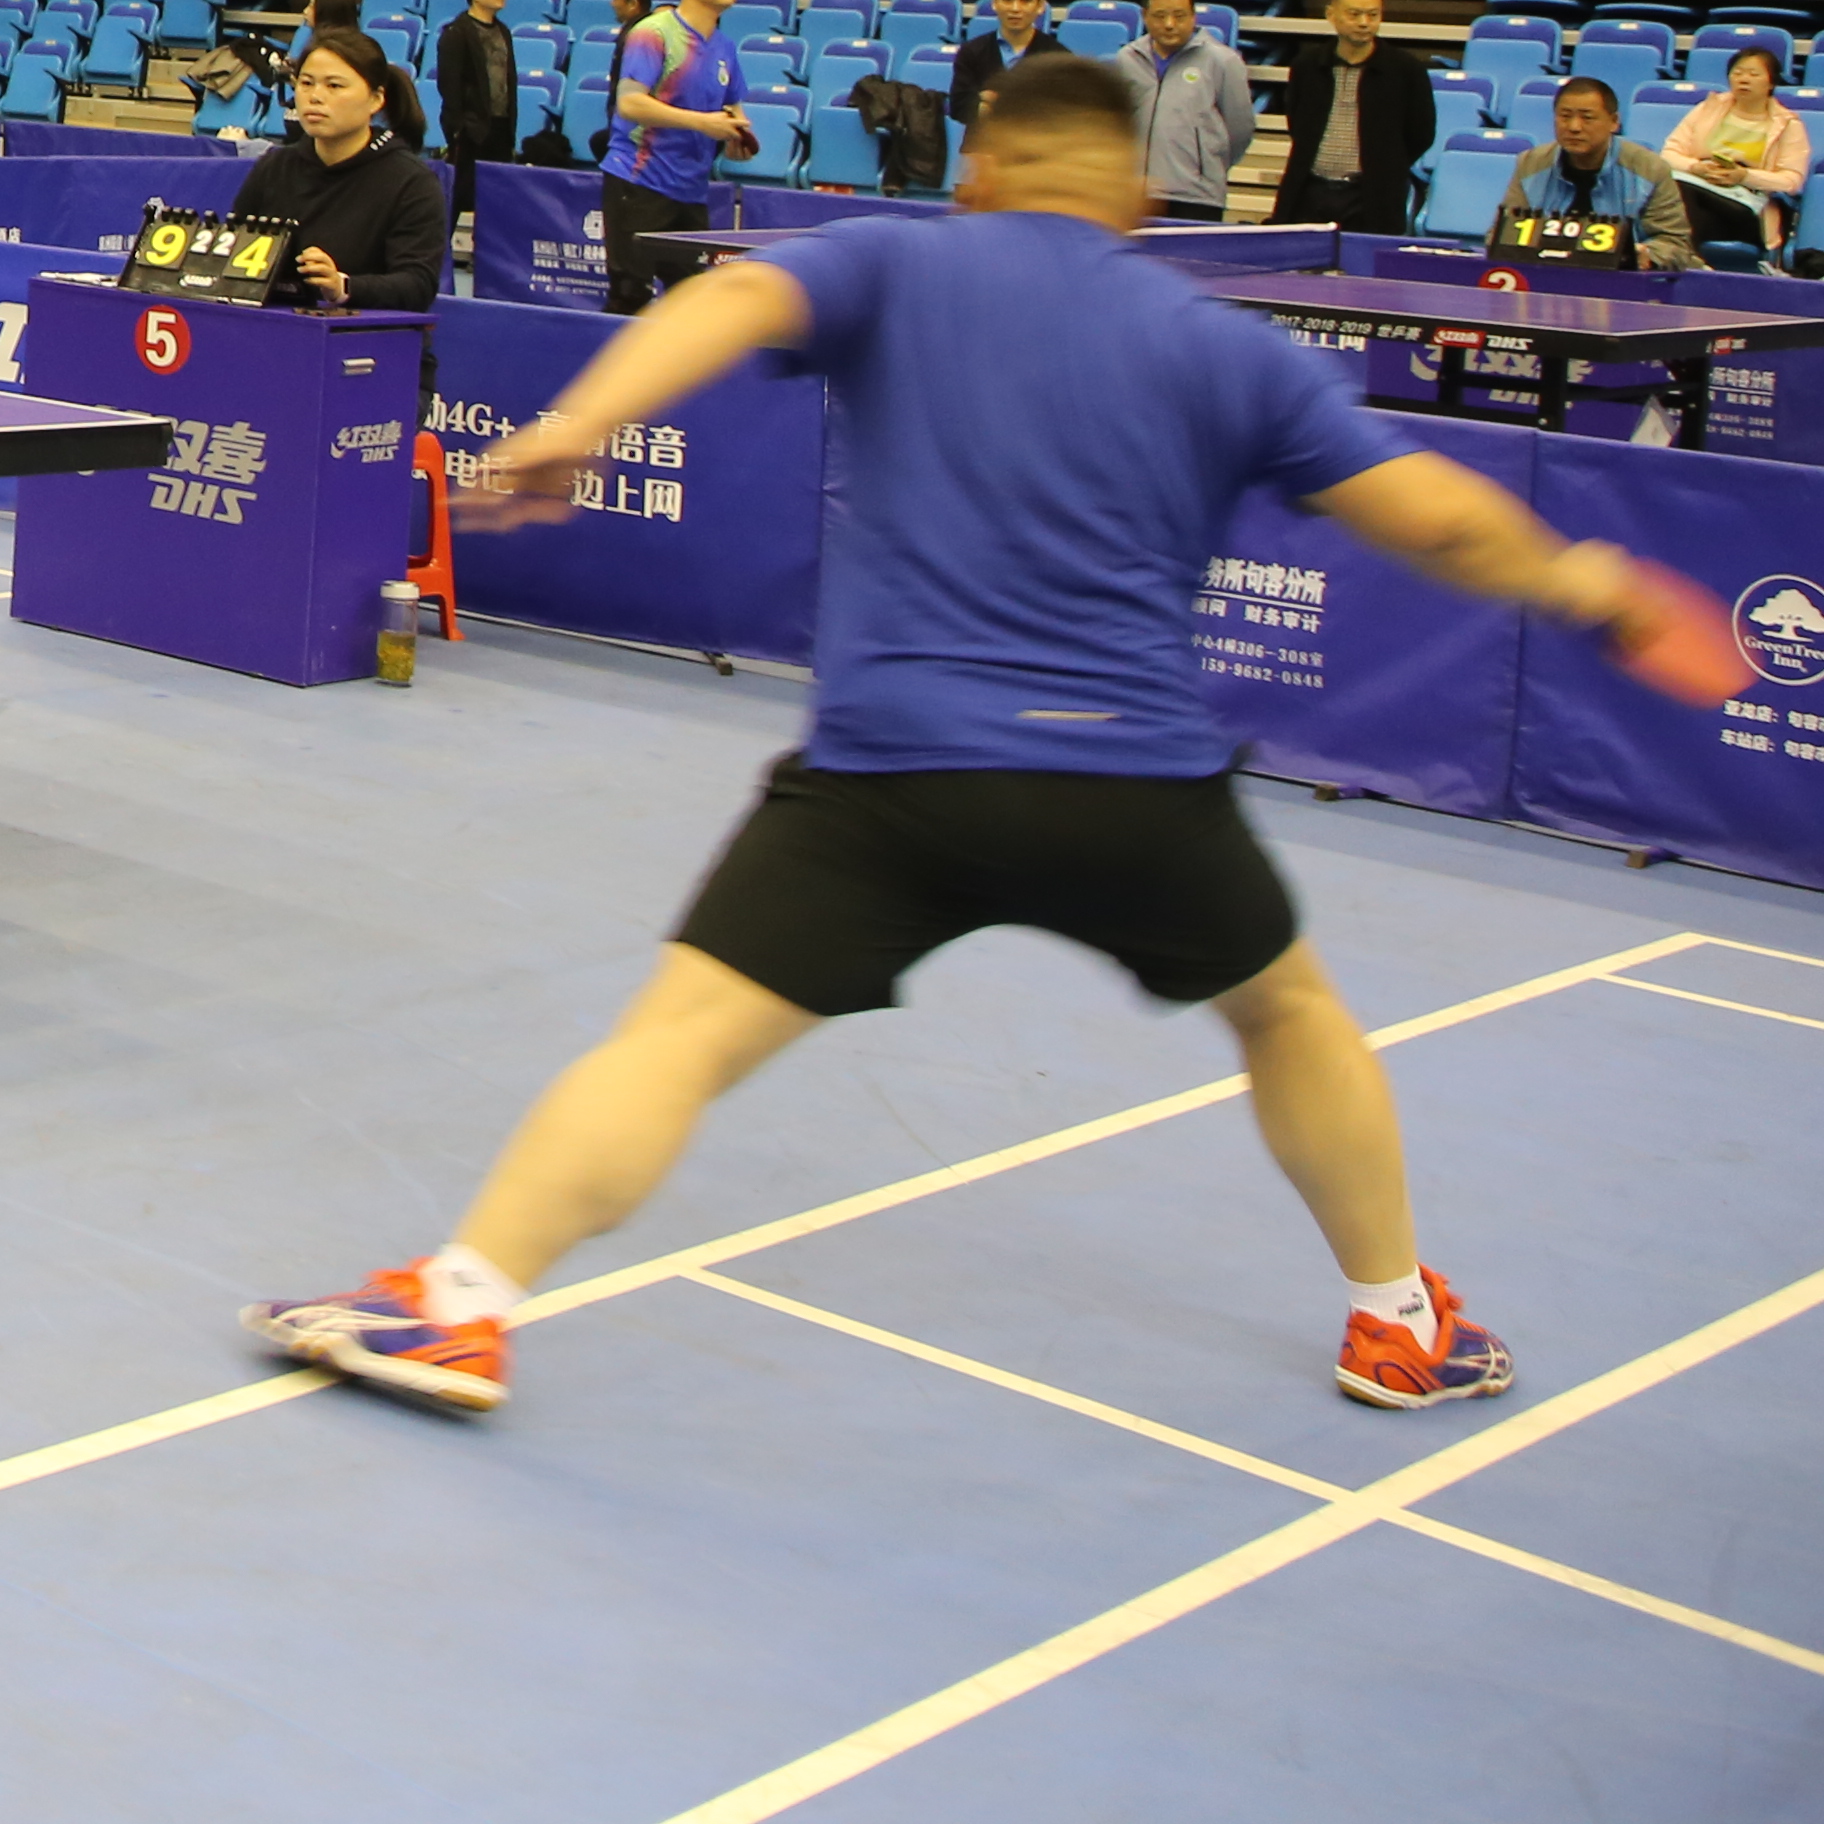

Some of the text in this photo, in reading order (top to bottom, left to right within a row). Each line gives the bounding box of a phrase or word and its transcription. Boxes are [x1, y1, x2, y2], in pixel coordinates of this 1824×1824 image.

[145, 224, 187, 266] 9
[190, 229, 213, 254] 2
[213, 231, 236, 256] 2
[232, 235, 274, 277] 4
[1514, 218, 1616, 252] 1 2 0 3
[145, 310, 179, 367] 5
[1486, 334, 1534, 351] DHS
[422, 393, 516, 440] 动4G+
[360, 445, 398, 464] DHS
[147, 471, 258, 525] DHS
[566, 471, 684, 523] 边上网
[1243, 603, 1322, 634] 财务审计
[1772, 652, 1805, 671] Inn
